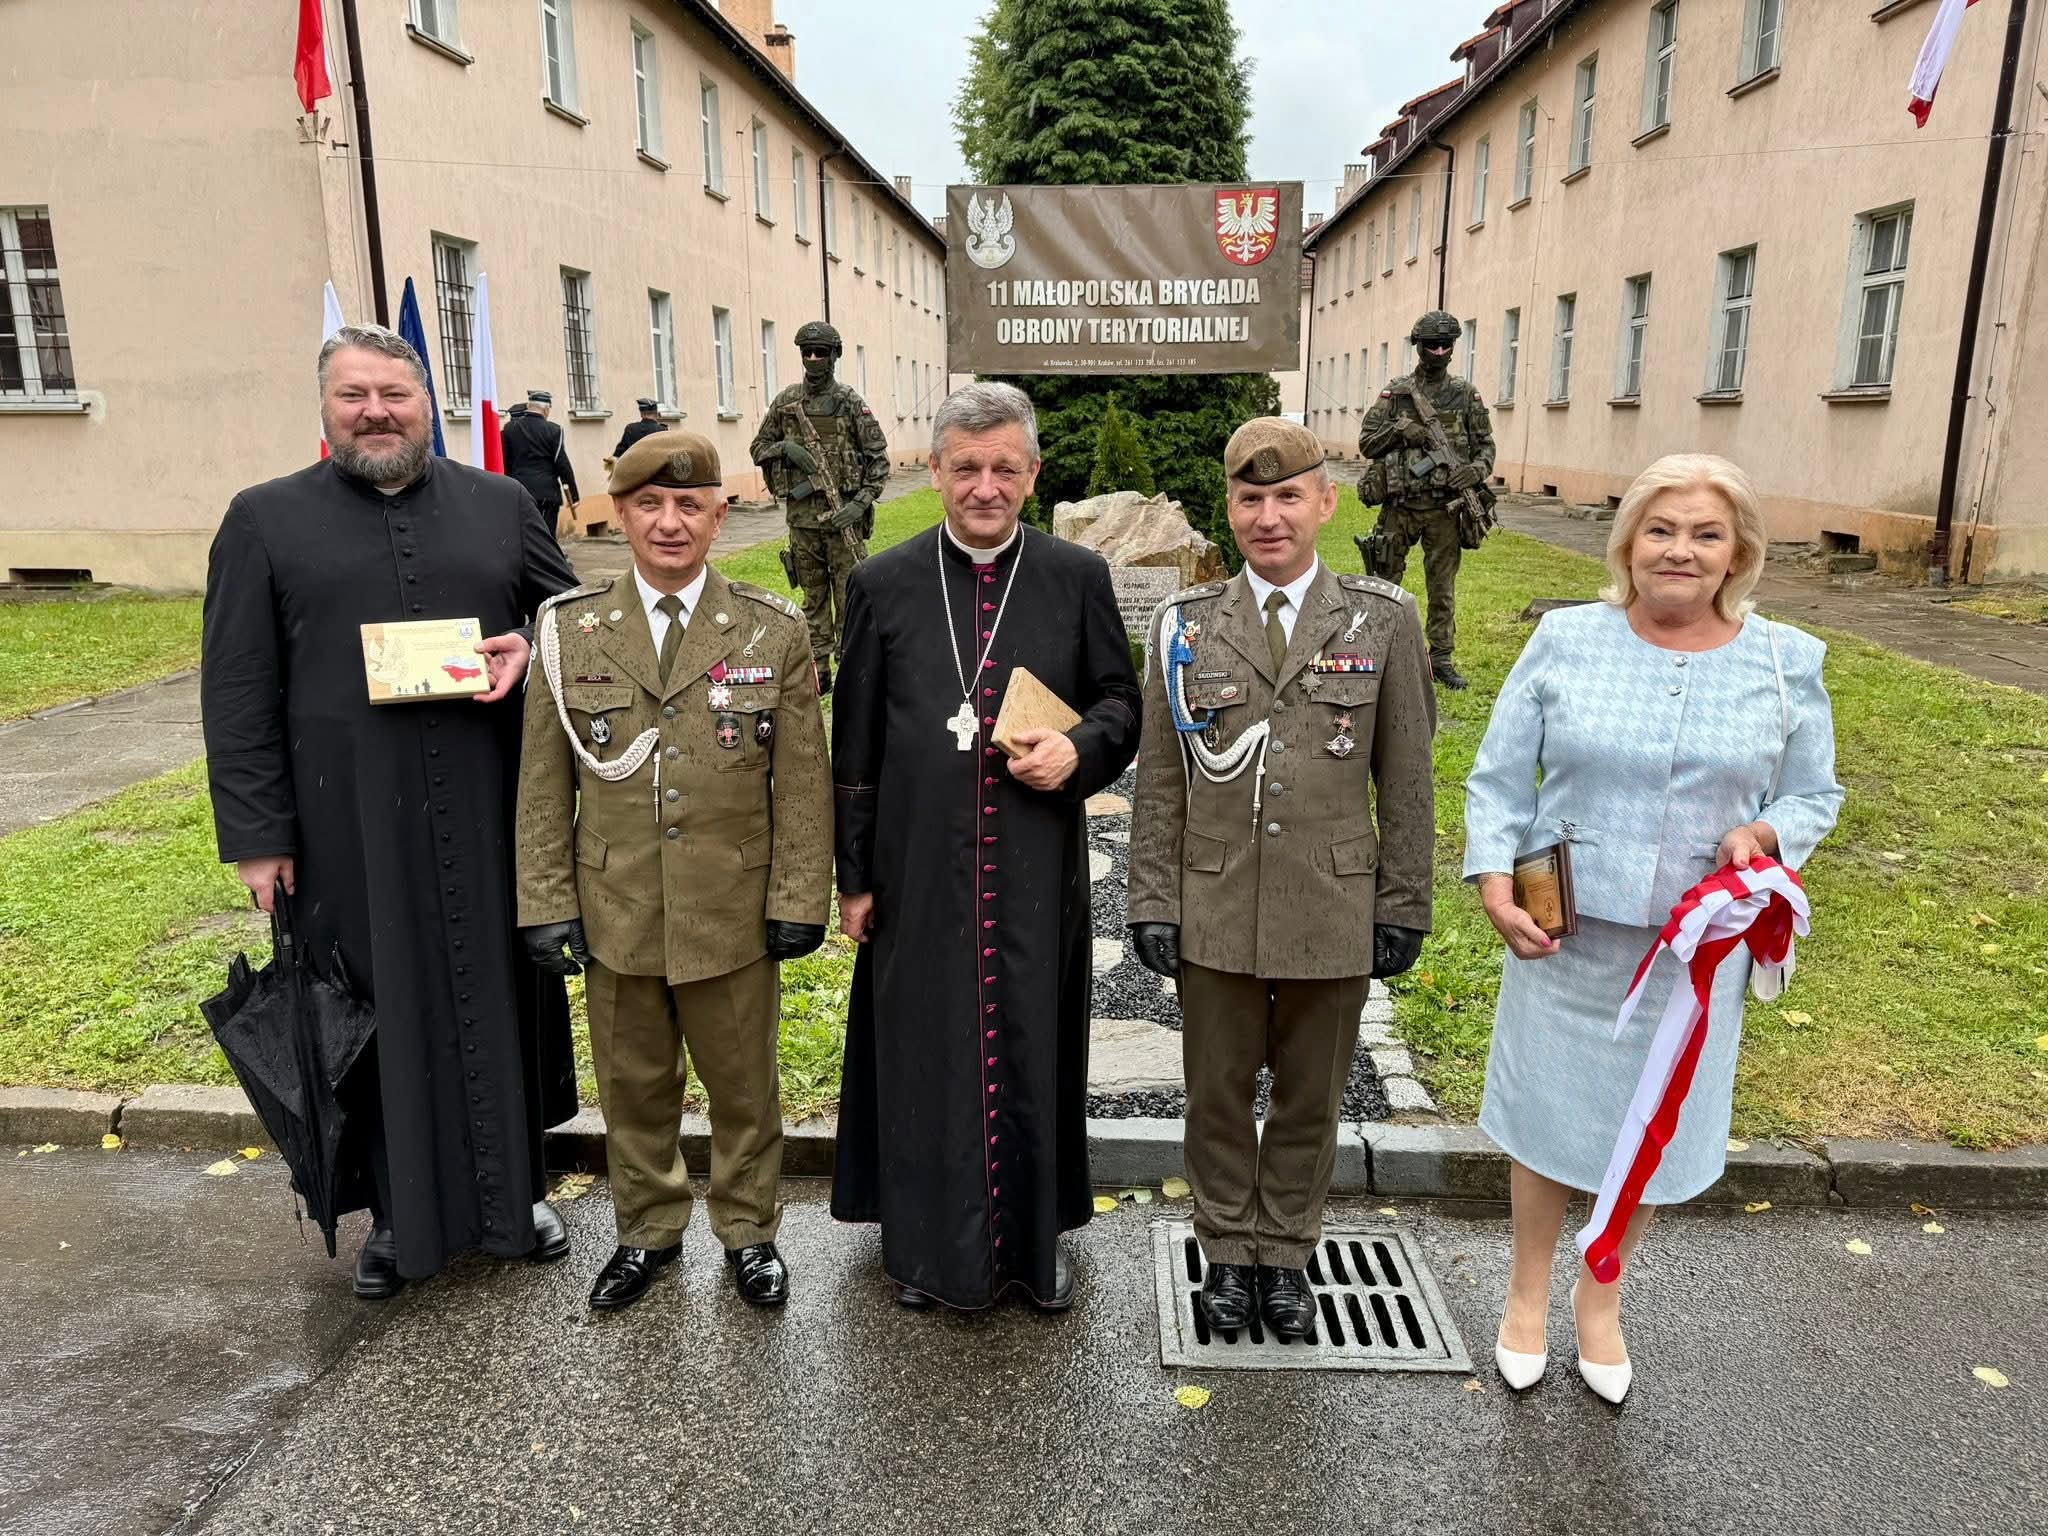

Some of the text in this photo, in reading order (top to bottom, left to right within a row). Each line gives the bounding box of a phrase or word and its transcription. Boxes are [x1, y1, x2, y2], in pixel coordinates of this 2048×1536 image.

[987, 278, 1261, 306] 11 MAŁOPOLSKA BRYGADA
[997, 316, 1249, 344] OBRONY TERYTORIALNEJ
